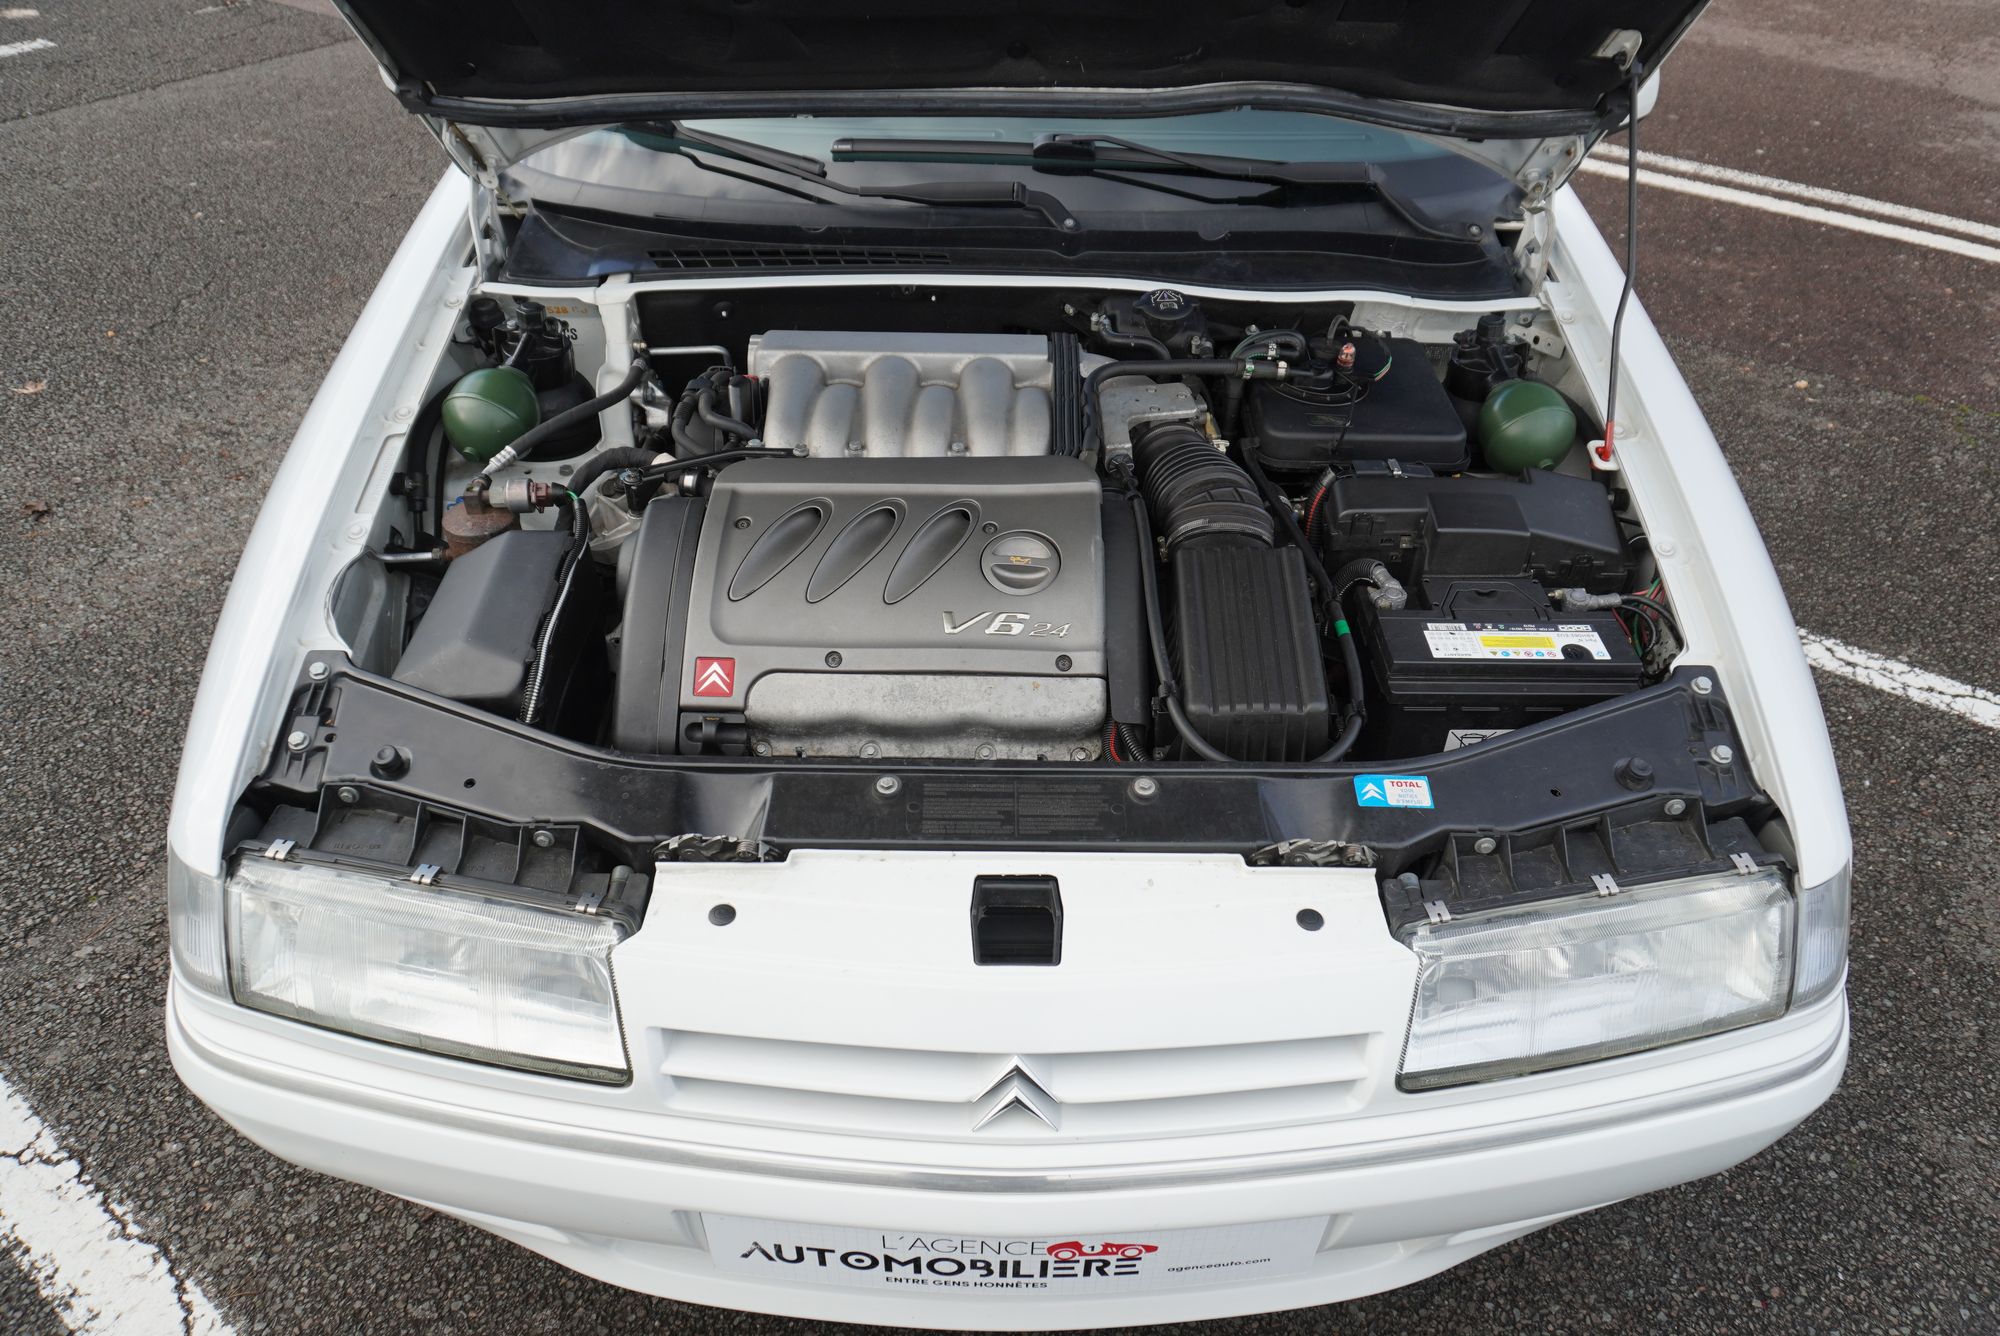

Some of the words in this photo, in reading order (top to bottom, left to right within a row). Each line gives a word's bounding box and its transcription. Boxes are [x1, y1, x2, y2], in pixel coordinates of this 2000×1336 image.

[942, 611, 1031, 636] V6
[1029, 622, 1071, 638] 24
[882, 1235, 1048, 1256] L'AGENCE
[1167, 1258, 1271, 1272] agenceauto.com
[886, 1276, 929, 1285] ENTRE
[933, 1279, 970, 1287] GENS
[974, 1280, 1048, 1288] HONNÊTES
